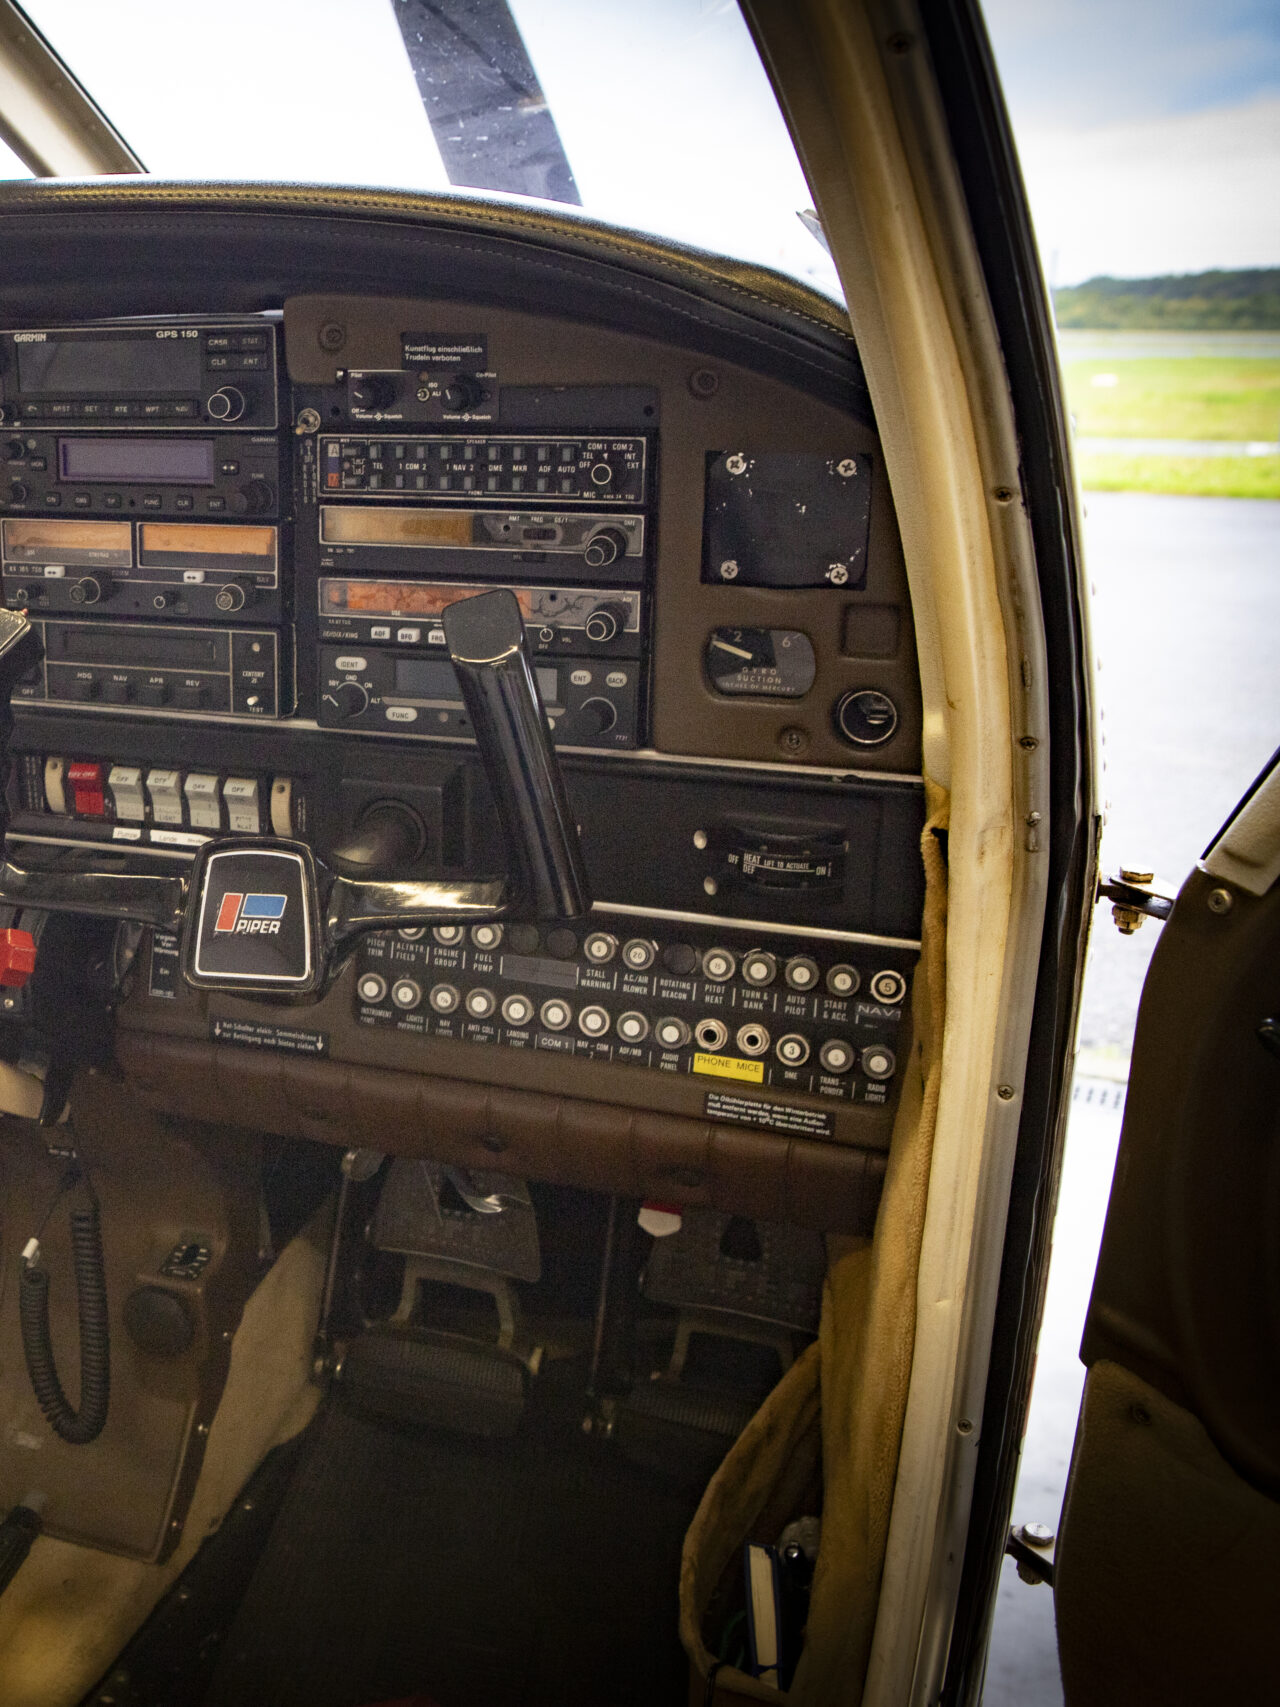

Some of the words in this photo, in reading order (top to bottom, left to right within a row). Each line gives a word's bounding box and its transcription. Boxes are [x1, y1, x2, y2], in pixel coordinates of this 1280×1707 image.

[13, 334, 46, 342] GARMIN
[156, 330, 178, 338] GPS
[180, 330, 198, 338] 150
[405, 345, 436, 354] Kunstflug
[211, 358, 226, 366] CLR
[587, 442, 602, 450] COM
[734, 631, 742, 642] 2
[782, 637, 790, 648] 6
[340, 660, 358, 668] IDENT
[742, 667, 777, 675] GYRO
[737, 675, 782, 684] SUCTION
[762, 684, 795, 692] MERCURY
[728, 853, 739, 864] OFF
[744, 853, 761, 864] HEAT
[743, 865, 755, 874] DEF
[763, 860, 774, 868] LIFT
[786, 862, 809, 870] ACTUATE
[816, 866, 826, 876] ON
[236, 920, 280, 934] PIPER
[367, 938, 385, 947] PITCH
[368, 948, 383, 957] TRIM
[396, 952, 415, 962] FIELD
[434, 947, 459, 958] ENGINE
[475, 952, 492, 963] FUEL
[633, 951, 642, 959] 20
[434, 958, 457, 967] GROUP
[473, 963, 492, 973] PUMP
[586, 969, 606, 978] STALL
[580, 978, 611, 990] WARNING
[623, 984, 648, 994] BLOWER
[660, 978, 691, 990] ROTATING
[704, 984, 725, 994] PITOT
[884, 982, 891, 992] 5
[662, 989, 687, 1000] BEACON
[704, 994, 723, 1004] HEAT
[741, 989, 760, 1000] TURN
[743, 1000, 763, 1010] BANK
[786, 995, 805, 1005] AUTO
[823, 1000, 847, 1010] START
[361, 1007, 392, 1018] INSTRUMENT
[784, 1005, 805, 1015] PILOT
[406, 1013, 423, 1023] LIGHTS
[832, 1011, 848, 1022] ACC.
[440, 1019, 450, 1027] NAV
[468, 1023, 479, 1032] ANTI
[482, 1025, 494, 1035] COLL
[473, 1034, 488, 1042] LIGHT
[506, 1029, 529, 1040] LANDING
[541, 1037, 561, 1048] COM
[577, 1040, 588, 1048] NAV
[596, 1043, 608, 1051] COM
[789, 1045, 795, 1054] 3
[662, 1052, 679, 1061] AUDIO
[660, 1061, 678, 1071] PANEL
[696, 1055, 731, 1068] PHONE
[736, 1062, 759, 1072] MICE
[784, 1071, 797, 1080] DME
[867, 1082, 886, 1093] RADIO
[772, 1104, 785, 1112] den
